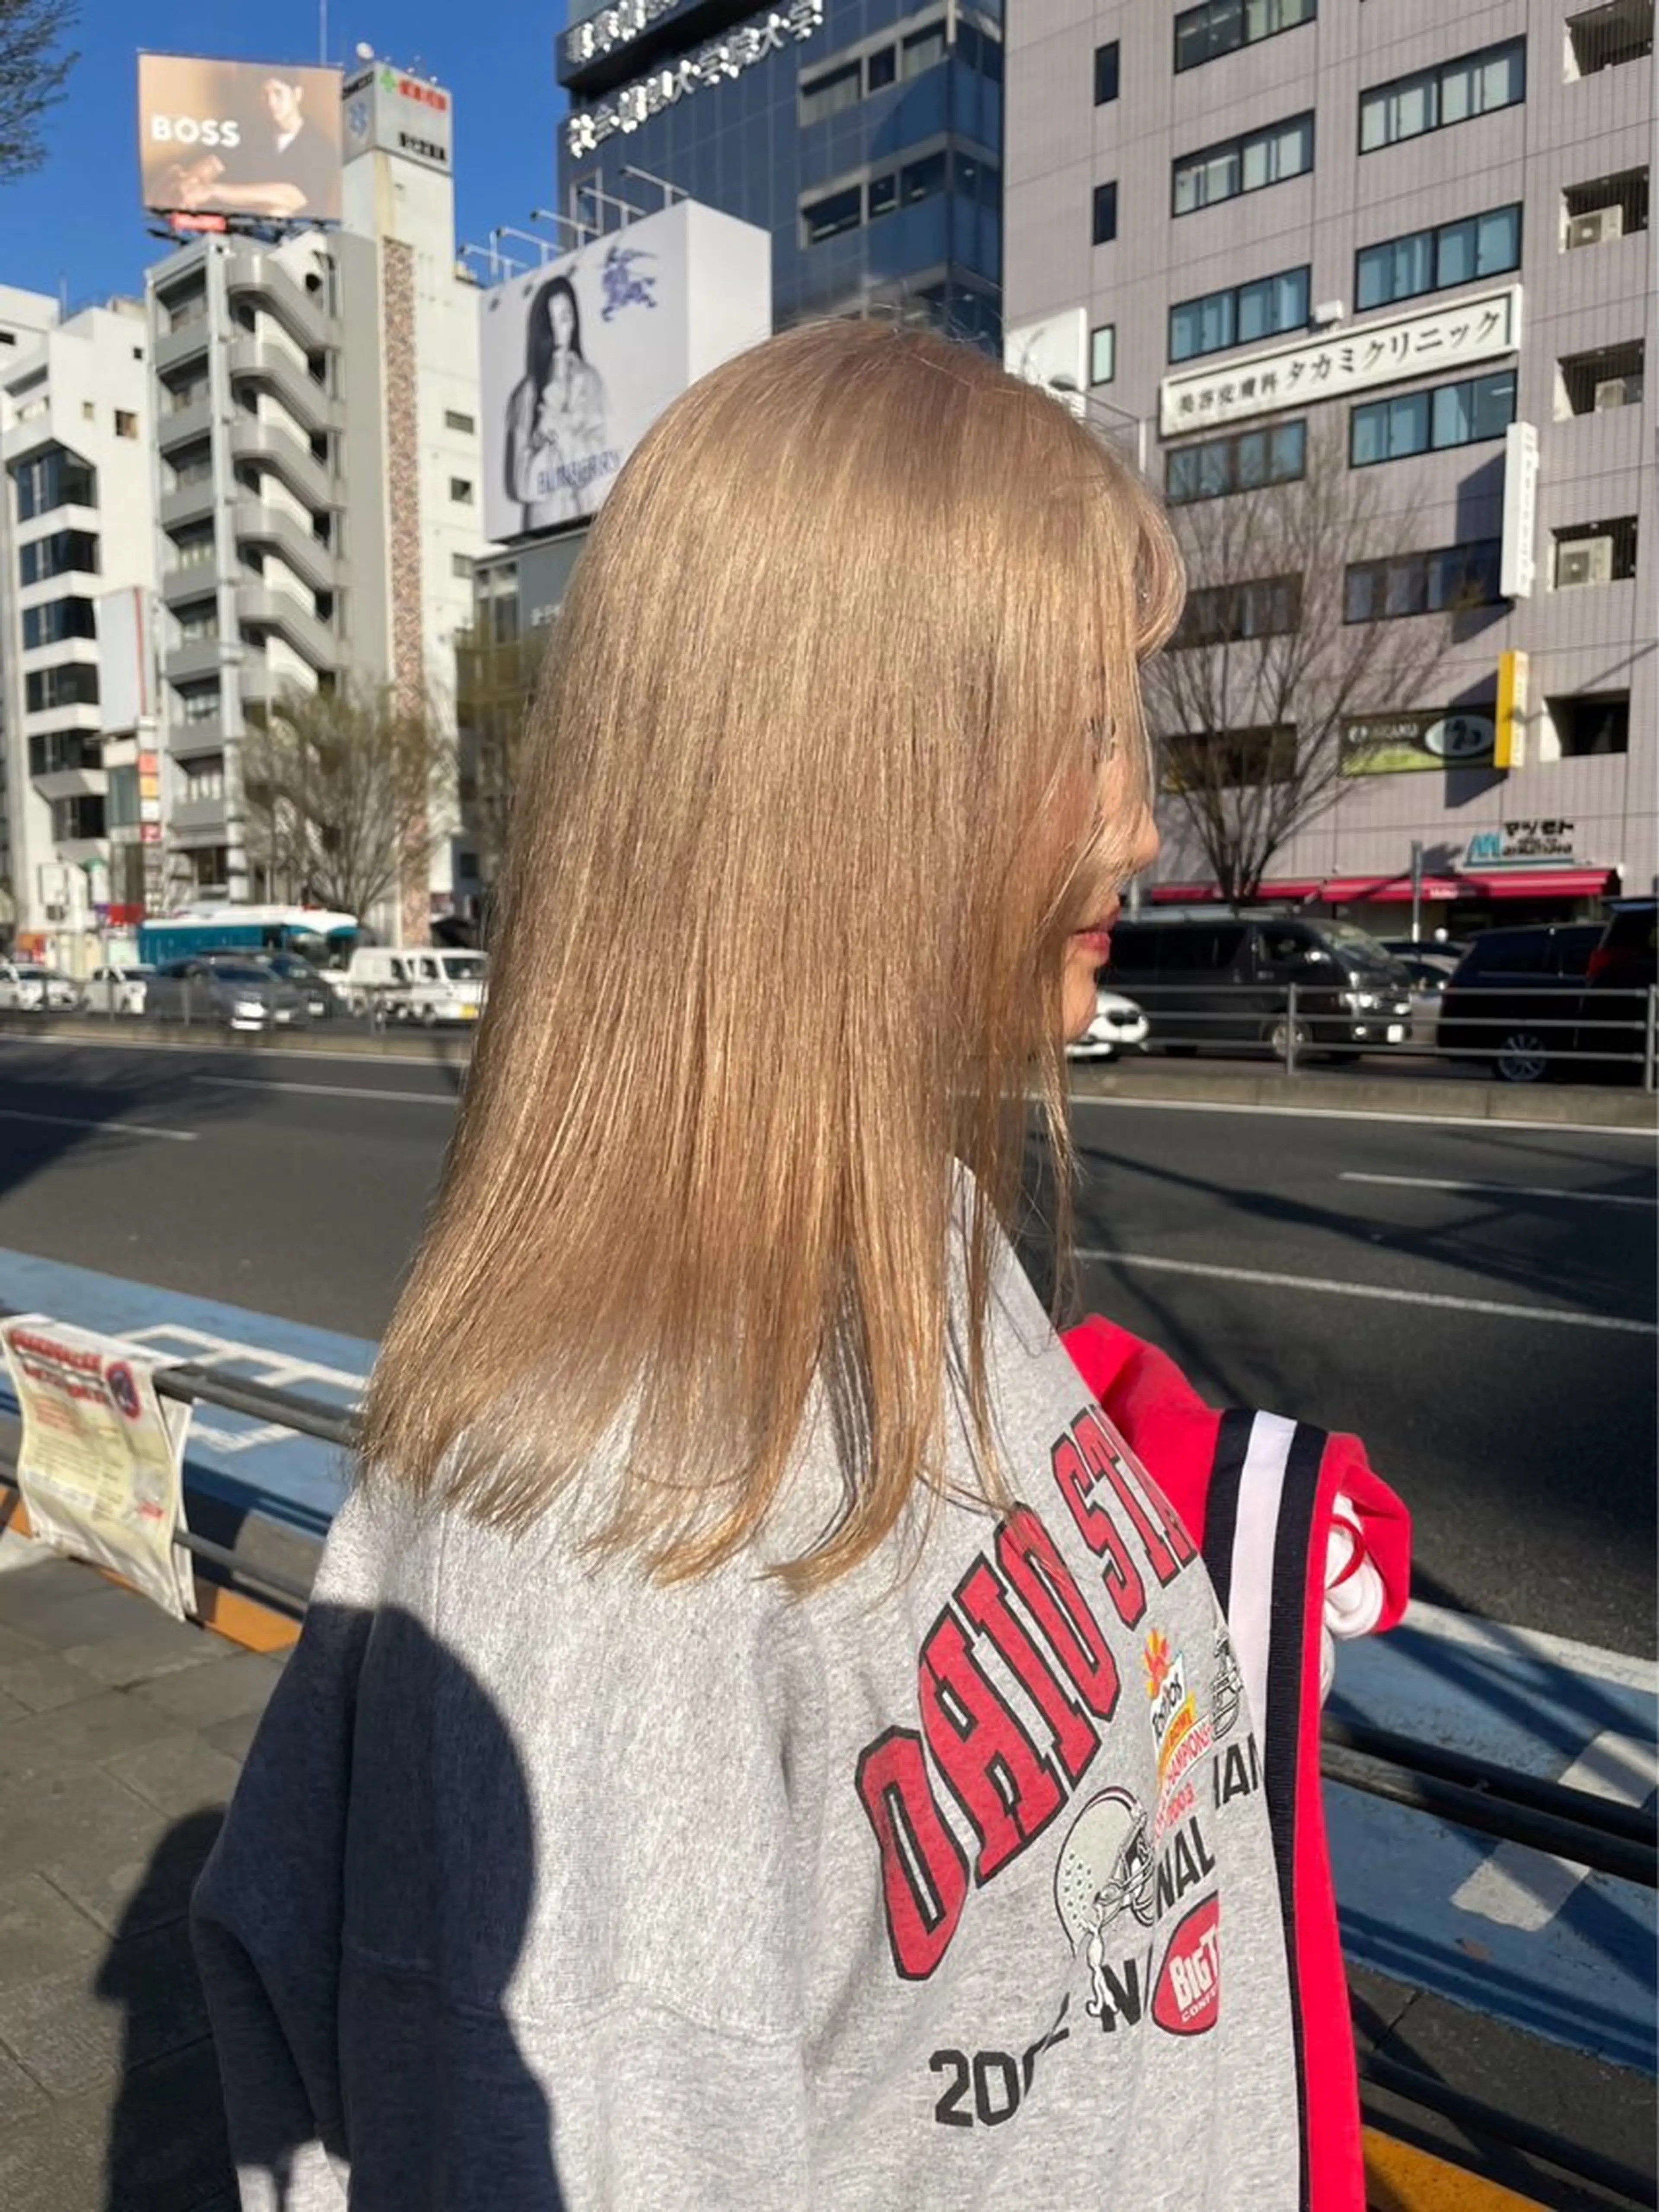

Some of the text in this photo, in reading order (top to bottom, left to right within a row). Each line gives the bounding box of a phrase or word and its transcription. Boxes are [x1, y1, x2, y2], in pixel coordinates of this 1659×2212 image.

[152, 115, 241, 148] BOSS
[1286, 310, 1500, 390] タカミクリニック
